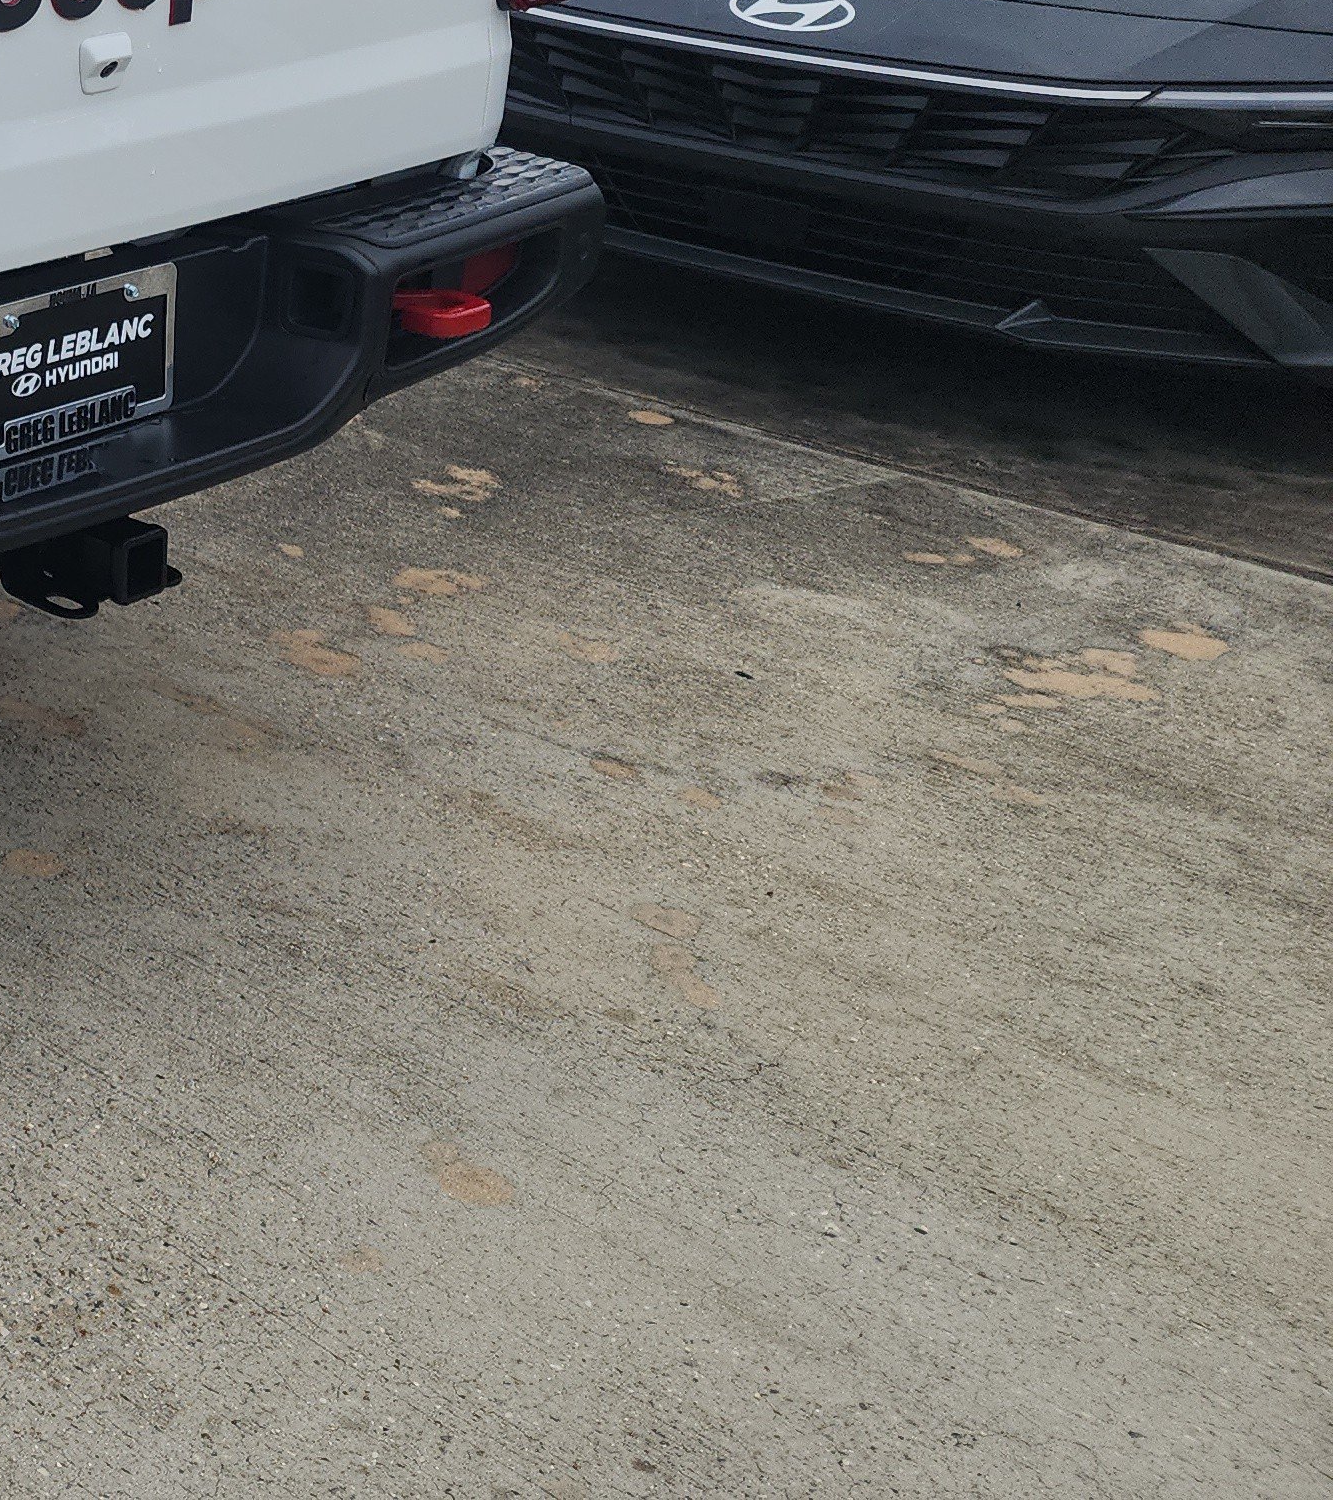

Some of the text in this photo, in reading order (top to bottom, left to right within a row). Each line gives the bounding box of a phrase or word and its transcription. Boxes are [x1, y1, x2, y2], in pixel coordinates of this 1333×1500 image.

[46, 313, 155, 364] LEBLANC
[45, 351, 119, 387] HYUNDAI
[5, 414, 55, 454] GREG
